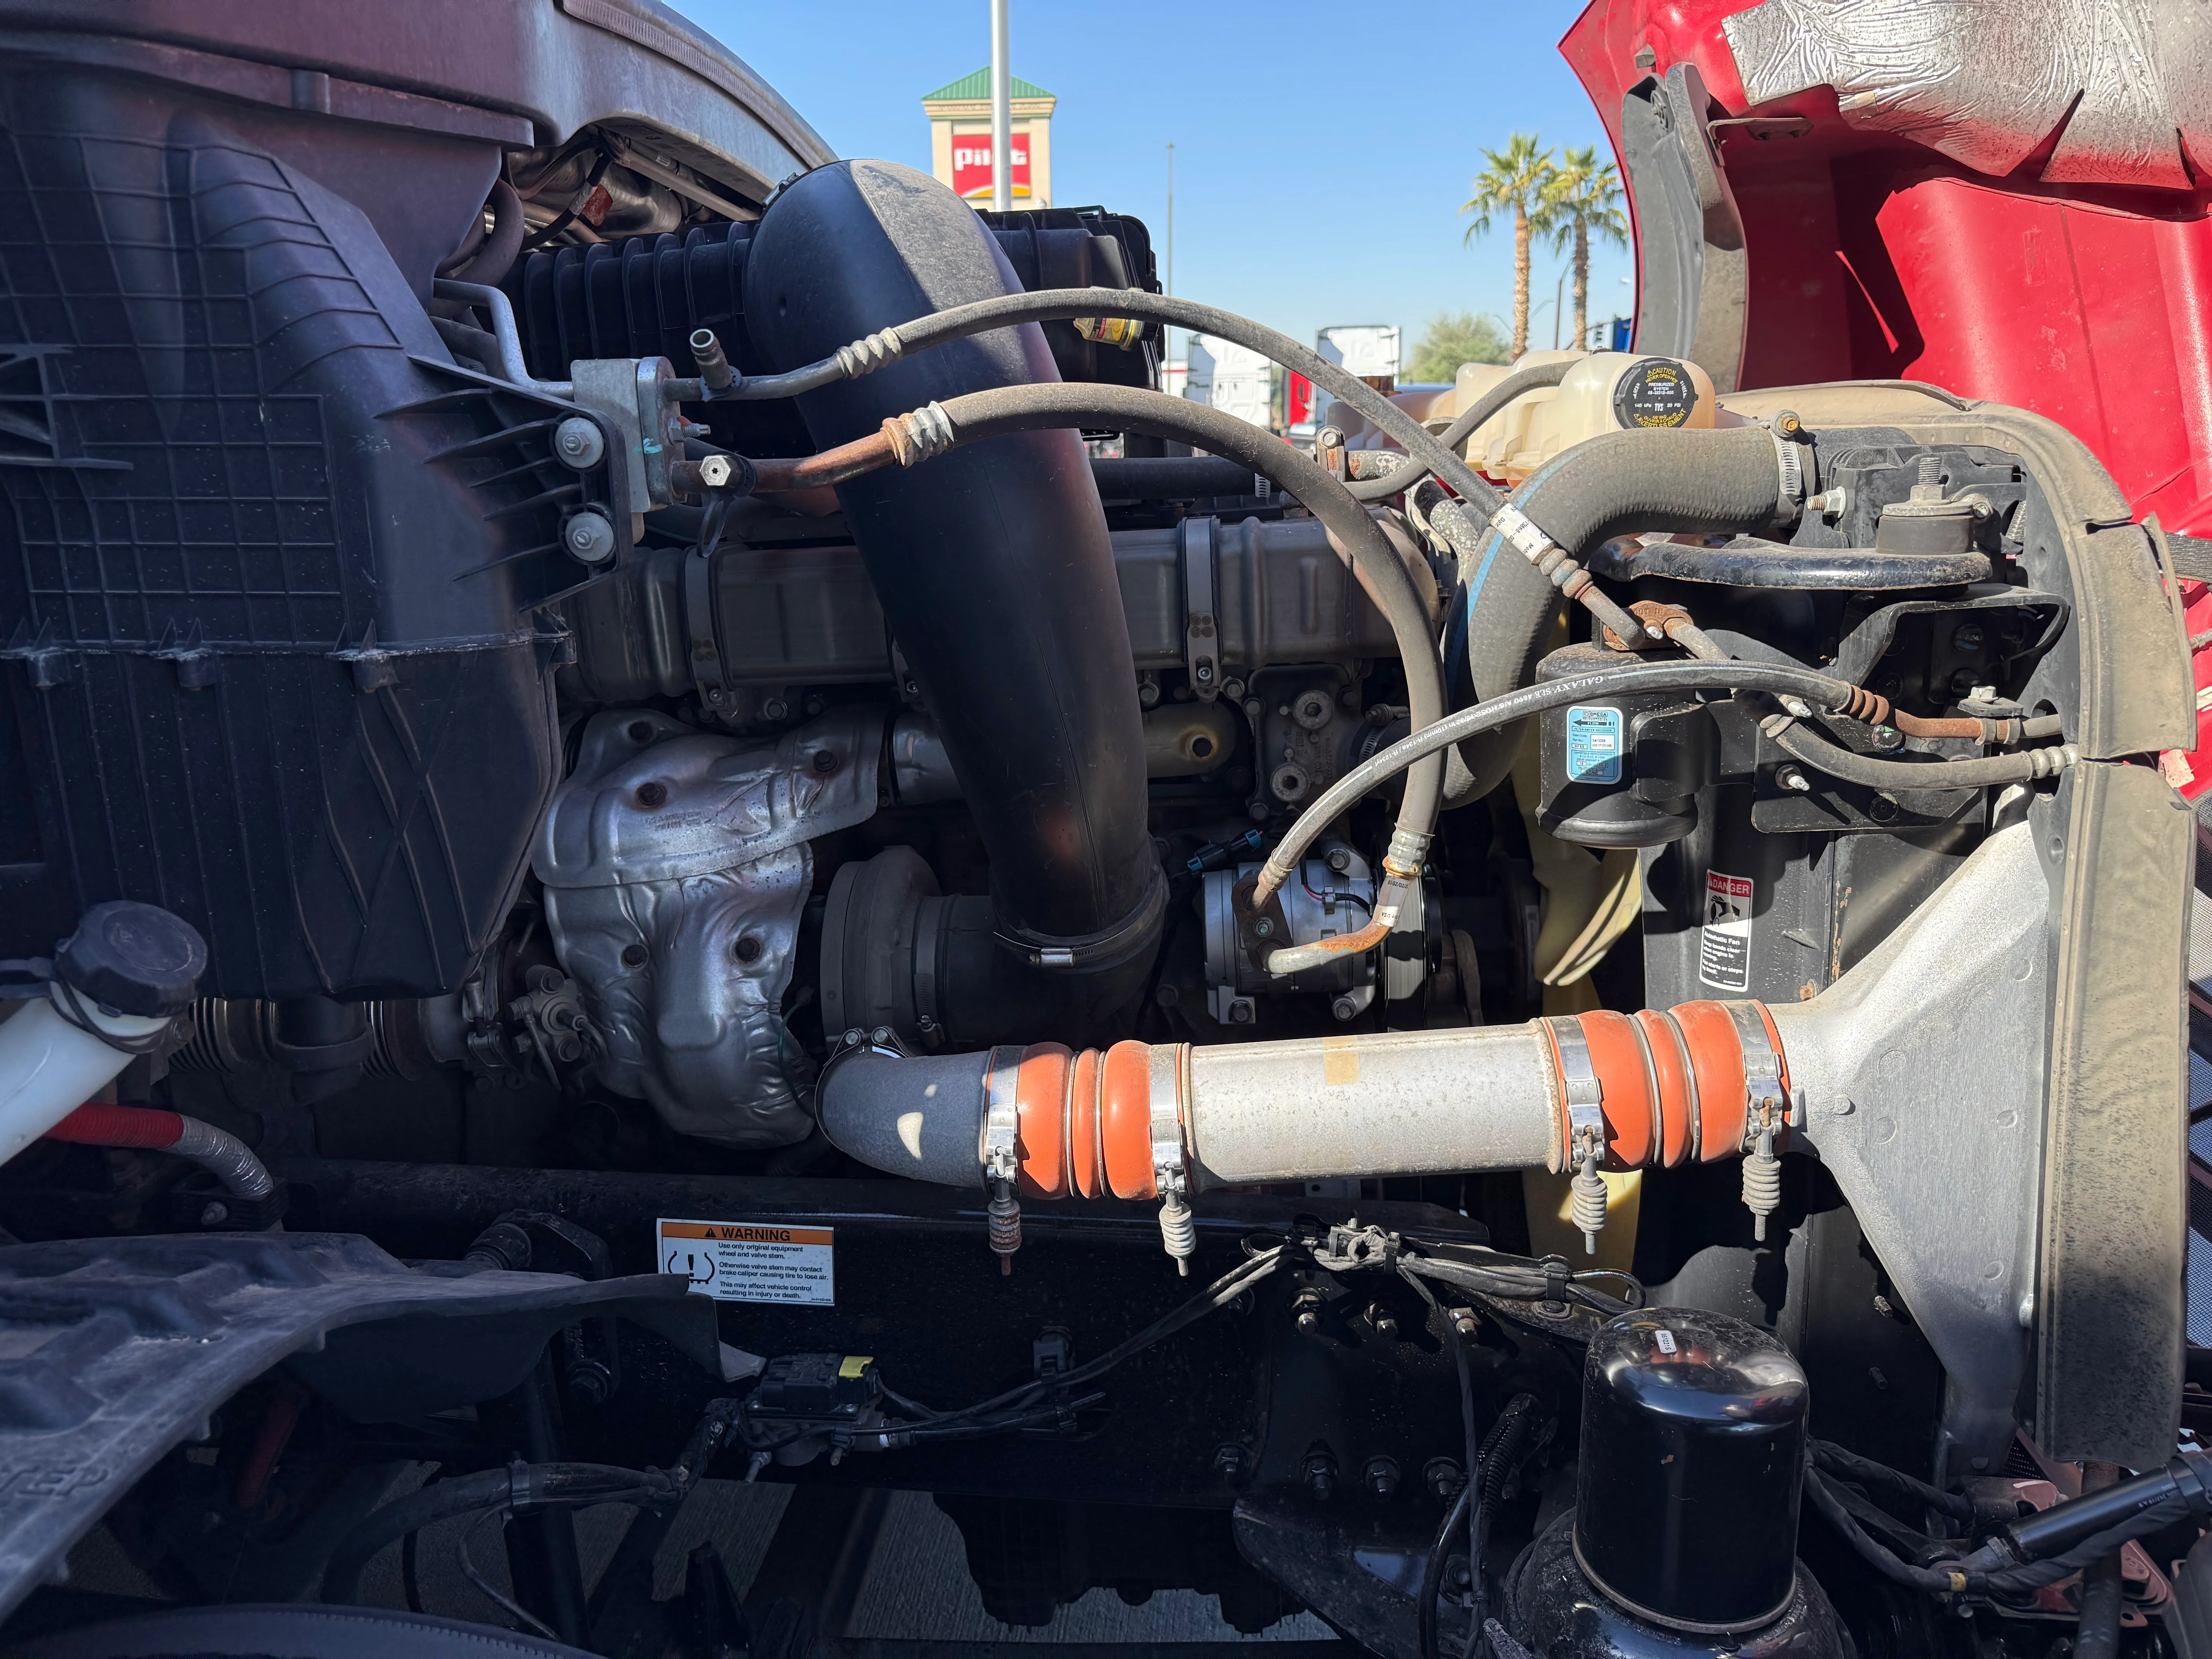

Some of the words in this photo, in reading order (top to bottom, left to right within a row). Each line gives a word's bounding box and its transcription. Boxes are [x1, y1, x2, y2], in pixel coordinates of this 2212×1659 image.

[1652, 368, 1676, 376] CAUTION
[1645, 374, 1659, 383] NEVER
[1654, 403, 1664, 412] TVS
[1636, 408, 1686, 428] AVERTISSEMENT
[1663, 412, 1677, 422] CHAUD
[1554, 675, 1603, 693] GALAXY
[1514, 694, 1532, 703] 4890
[1534, 687, 1551, 698] SLE
[1476, 704, 1498, 718] HOSE
[1424, 724, 1448, 740] (10mm)
[1402, 738, 1423, 750] R-134a
[1374, 750, 1398, 768] R-1234yf
[1713, 879, 1749, 895] DANGER
[1704, 931, 1727, 943] Automatic
[721, 1227, 790, 1241] WARNING
